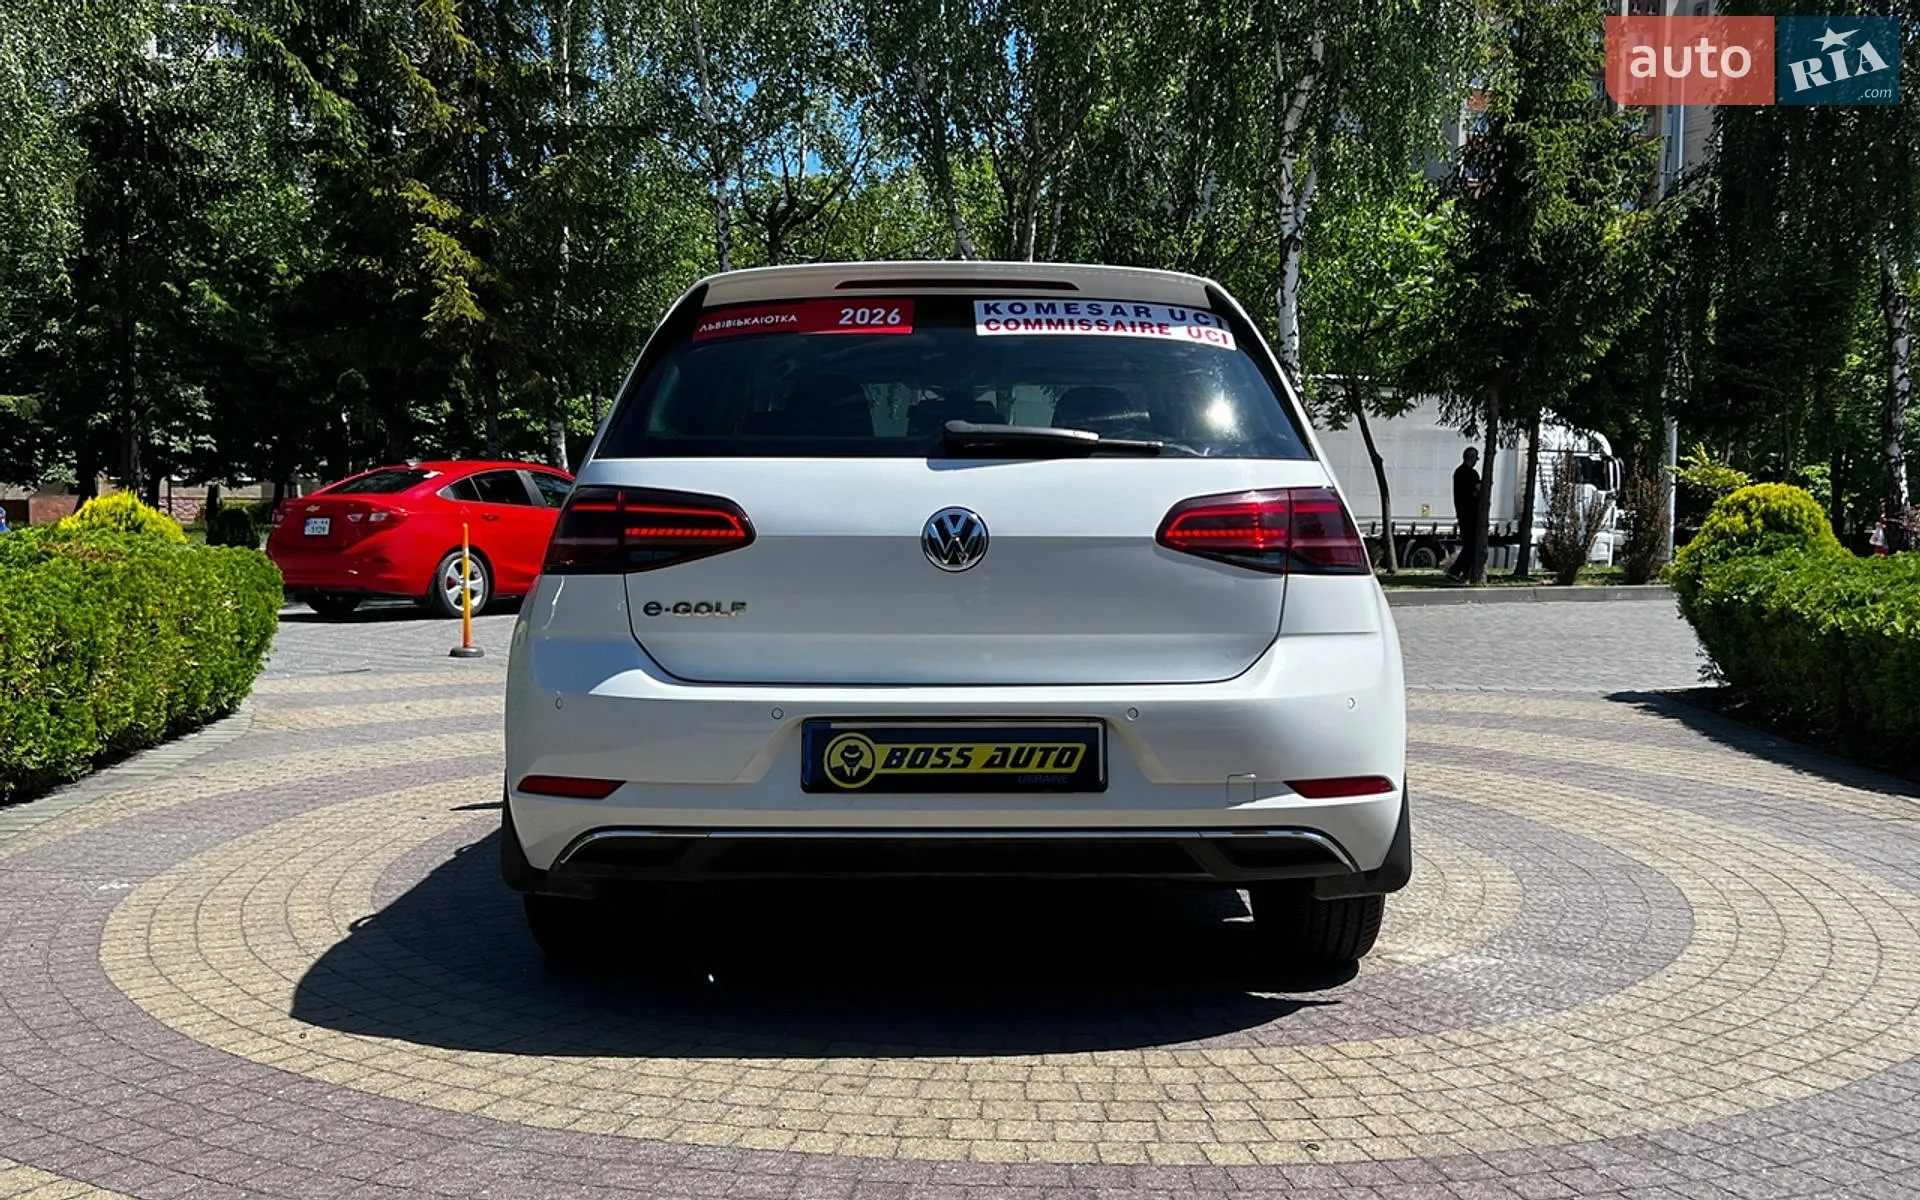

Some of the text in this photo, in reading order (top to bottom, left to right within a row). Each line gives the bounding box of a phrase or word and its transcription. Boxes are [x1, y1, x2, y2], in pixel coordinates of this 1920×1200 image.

[838, 308, 901, 325] 2026
[984, 302, 1225, 329] KOMESAR UCI
[983, 318, 1229, 345] COMMISSAIRE UCI
[643, 601, 747, 617] e-GOLF
[881, 746, 1081, 769] BOSS AUTO
[1017, 774, 1071, 784] UKRAINE
